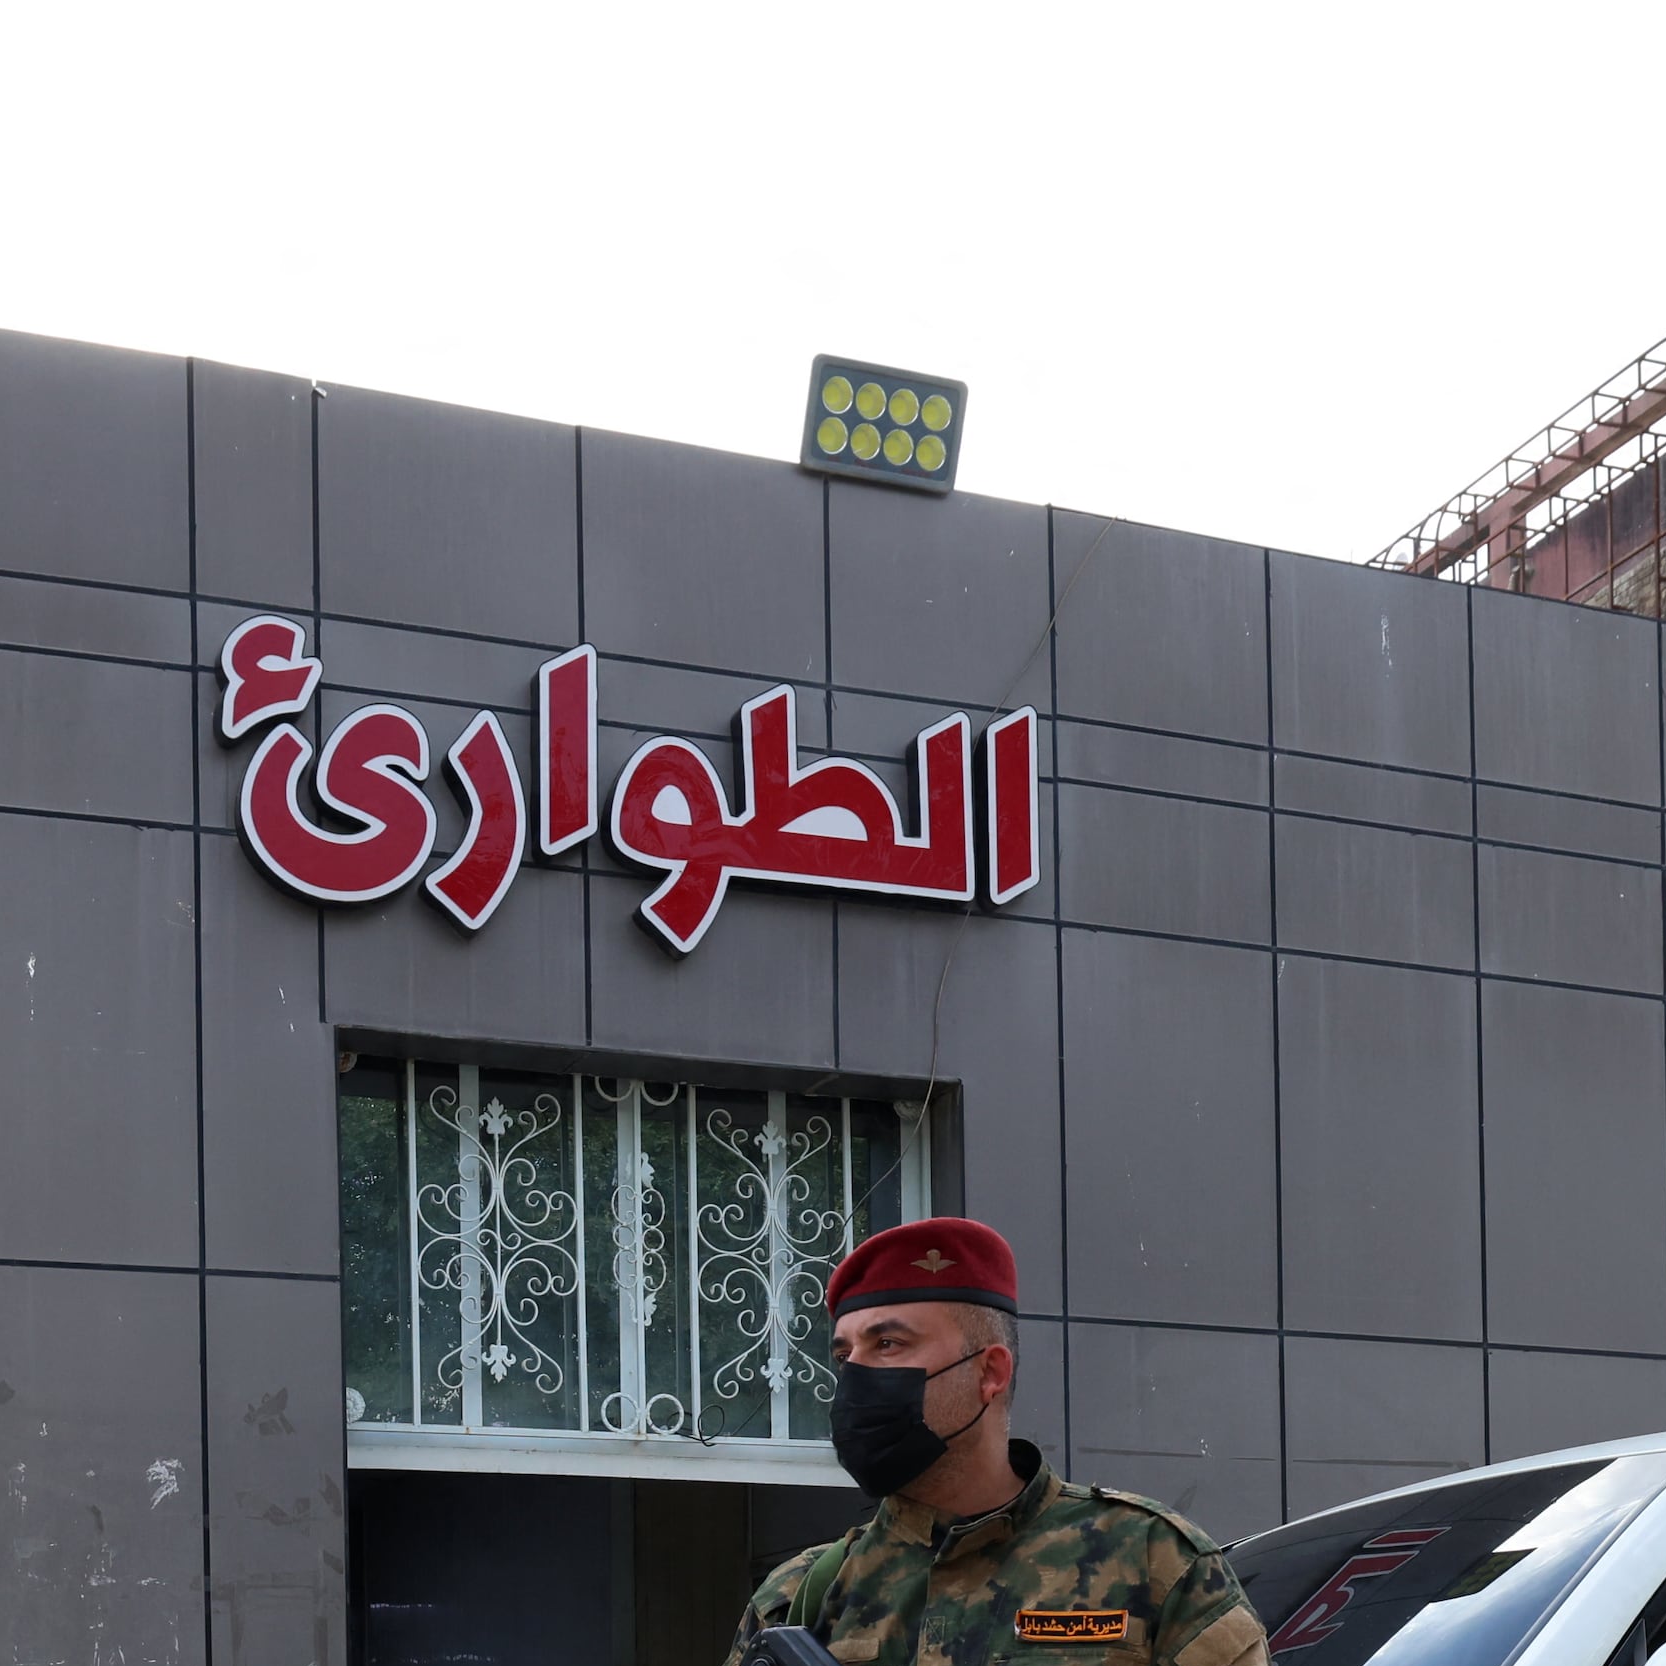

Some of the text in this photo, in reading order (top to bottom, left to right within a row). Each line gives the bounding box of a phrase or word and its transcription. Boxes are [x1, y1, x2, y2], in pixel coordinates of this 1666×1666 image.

[217, 613, 1040, 956] الطوارئ
[1021, 1616, 1122, 1636] مديرية أمن حشد بابل
